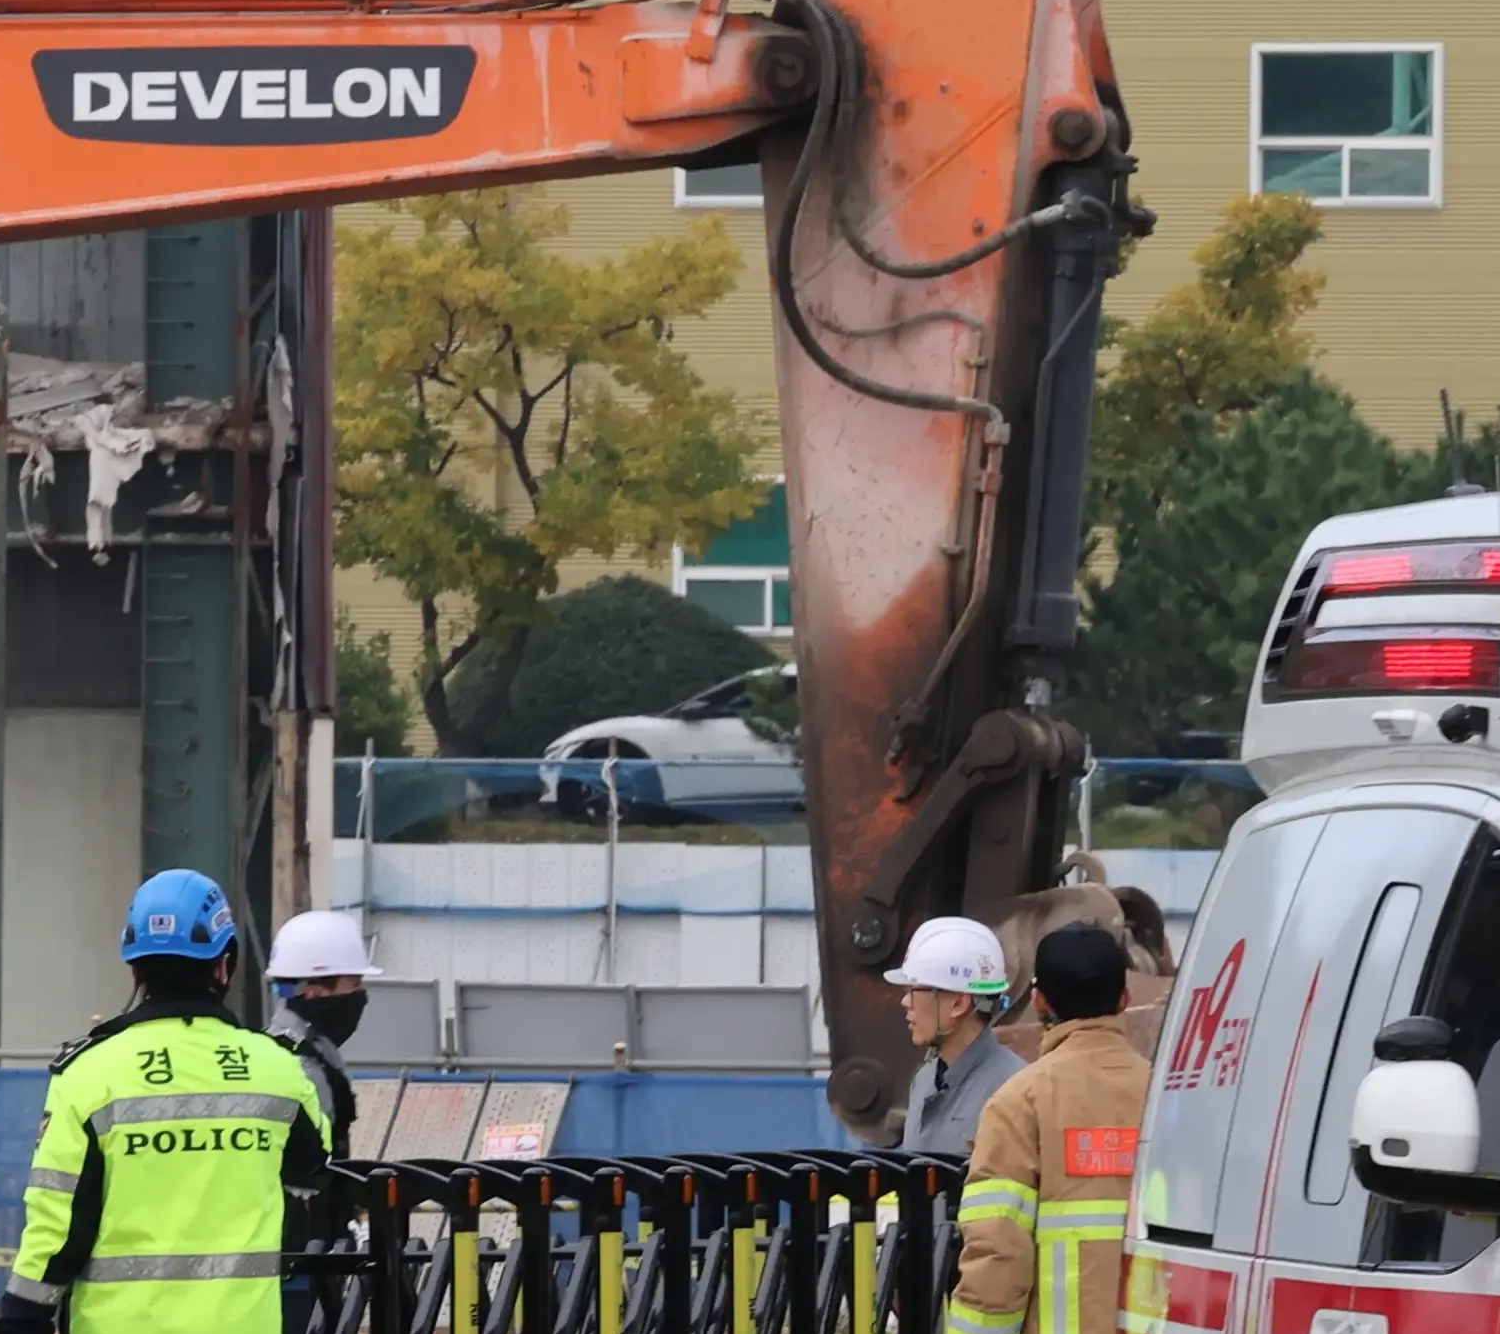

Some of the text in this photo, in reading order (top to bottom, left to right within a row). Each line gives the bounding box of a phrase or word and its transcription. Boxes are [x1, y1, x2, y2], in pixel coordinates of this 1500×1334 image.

[73, 67, 441, 122] DEVELON
[136, 1044, 252, 1085] 경찰
[124, 1127, 273, 1156] POLICE
